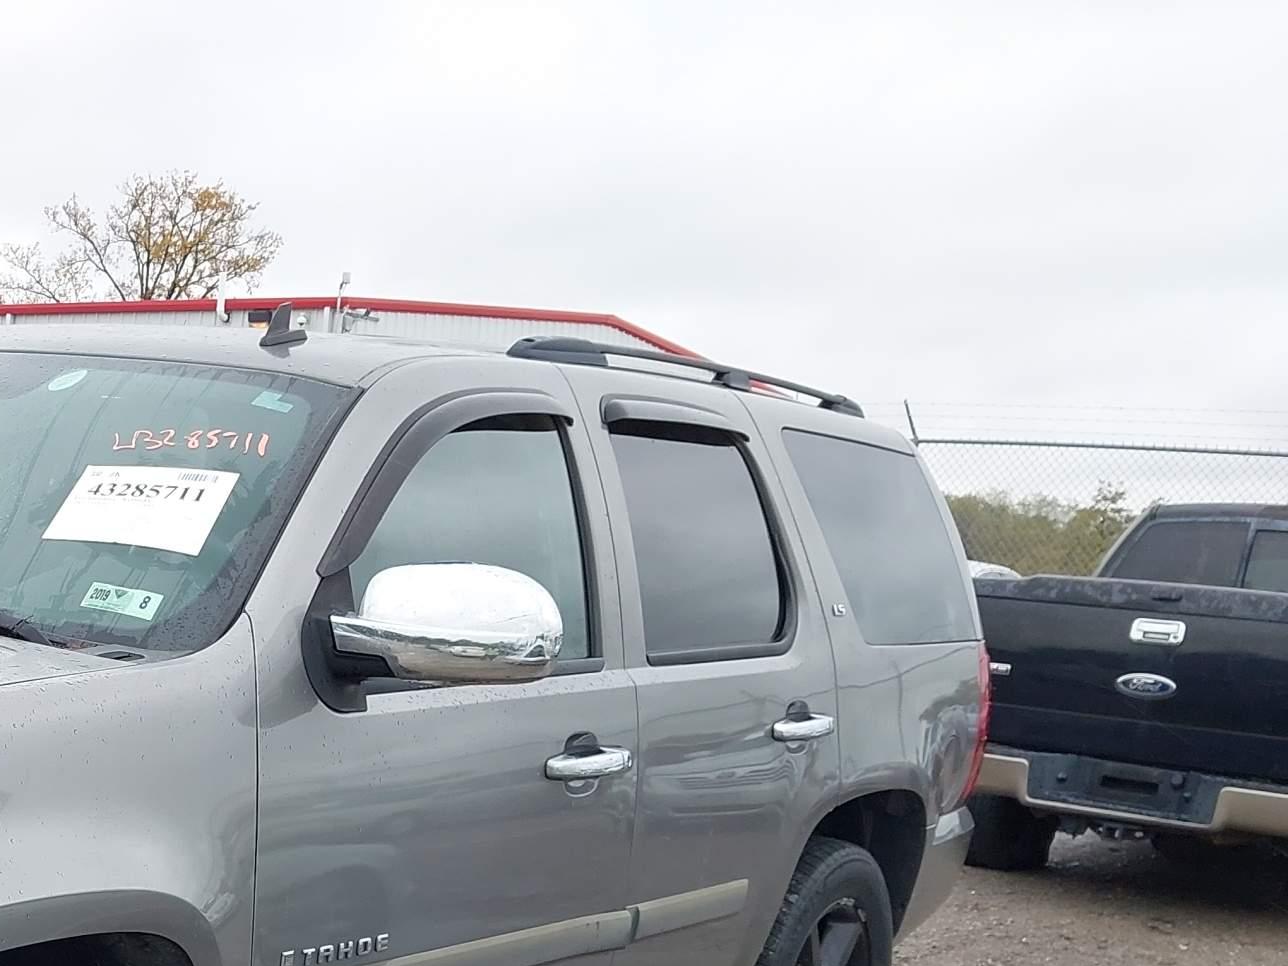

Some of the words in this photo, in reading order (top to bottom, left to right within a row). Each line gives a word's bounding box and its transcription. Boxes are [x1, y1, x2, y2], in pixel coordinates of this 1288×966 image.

[87, 482, 206, 502] 43285711
[89, 587, 112, 601] 2019
[139, 595, 152, 610] 8
[303, 933, 389, 966] TAHOE
